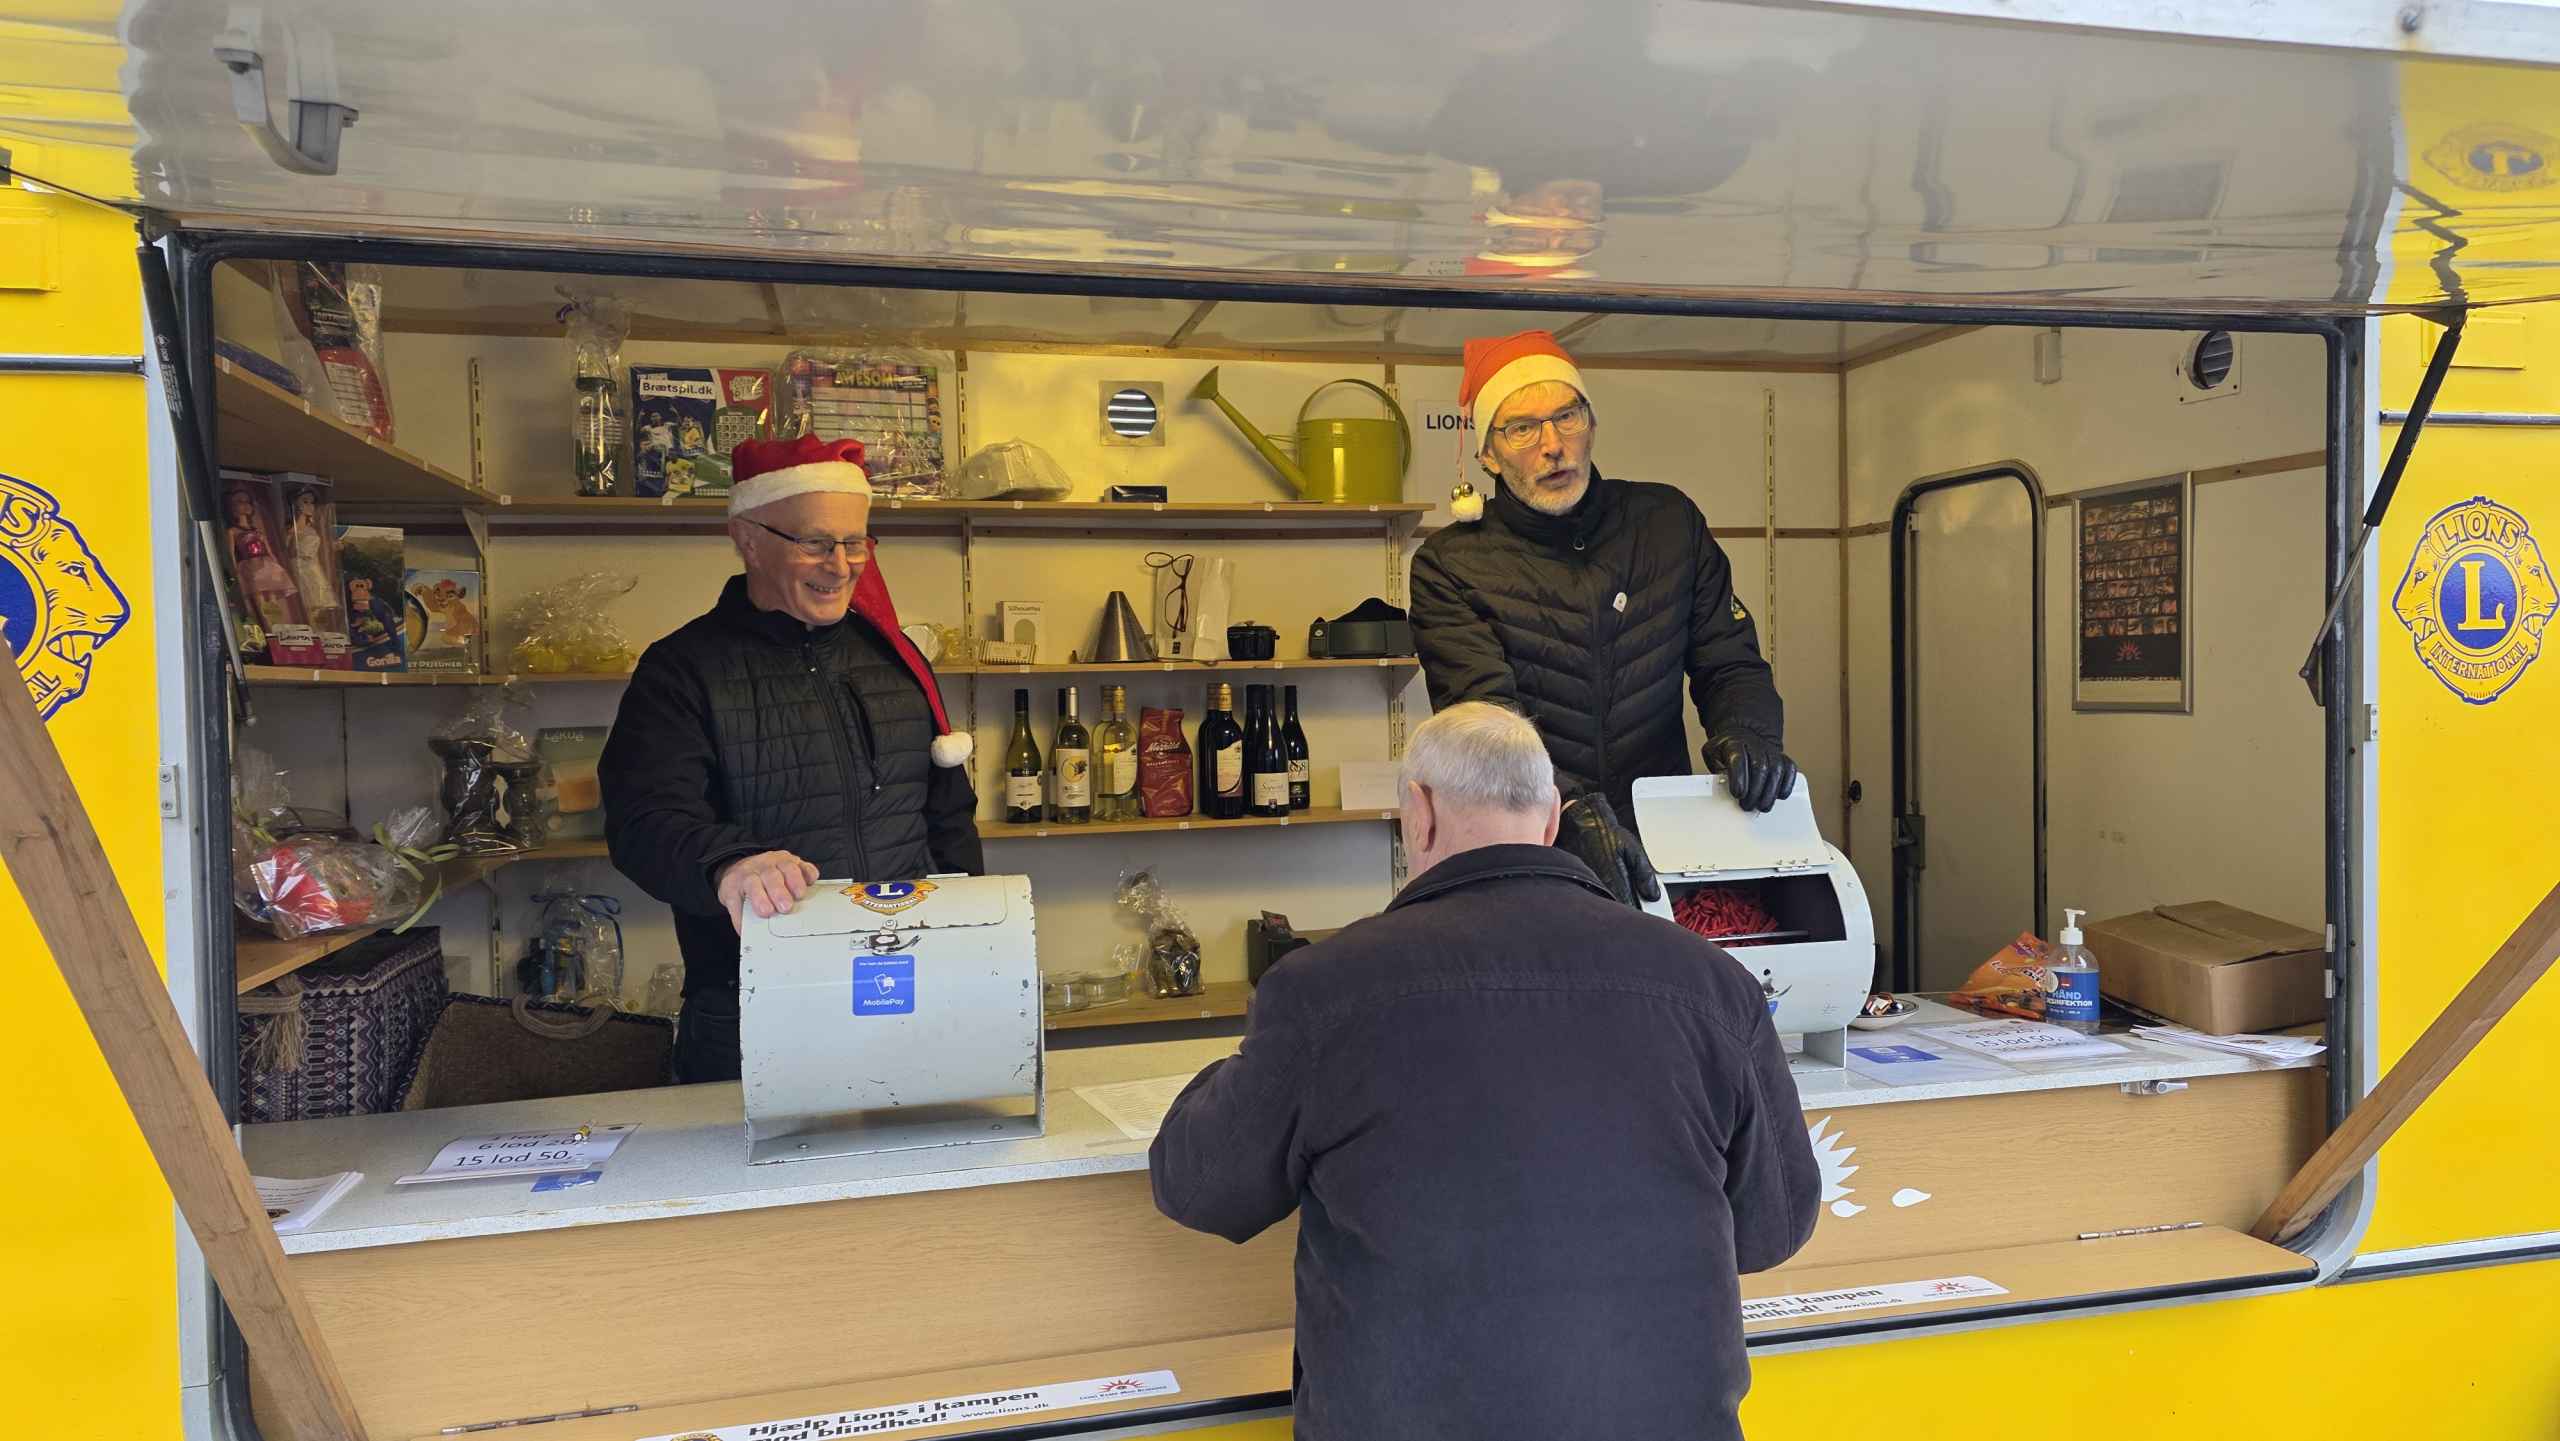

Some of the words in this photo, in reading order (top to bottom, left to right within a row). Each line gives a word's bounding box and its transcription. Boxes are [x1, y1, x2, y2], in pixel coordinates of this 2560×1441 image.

[642, 382, 713, 396] Brætspil.dk
[2434, 509, 2520, 550] LIONS
[2457, 560, 2506, 631] L
[2428, 640, 2529, 680] INTERNATIONAL
[876, 882, 904, 896] L
[863, 997, 905, 1007] MobilePay
[499, 1140, 540, 1149] lod
[455, 1155, 485, 1167] 15
[490, 1151, 532, 1165] lod
[537, 1150, 585, 1161] 50,-
[1742, 1300, 1781, 1312] ons
[1795, 1288, 1882, 1306] kampen
[749, 1418, 830, 1436] Hjælp
[838, 1407, 909, 1424] Lions
[917, 1403, 926, 1414] i
[934, 1390, 1039, 1412] kampen
[818, 1411, 949, 1438] blindhed!
[959, 1401, 1050, 1419] www.lions.dk
